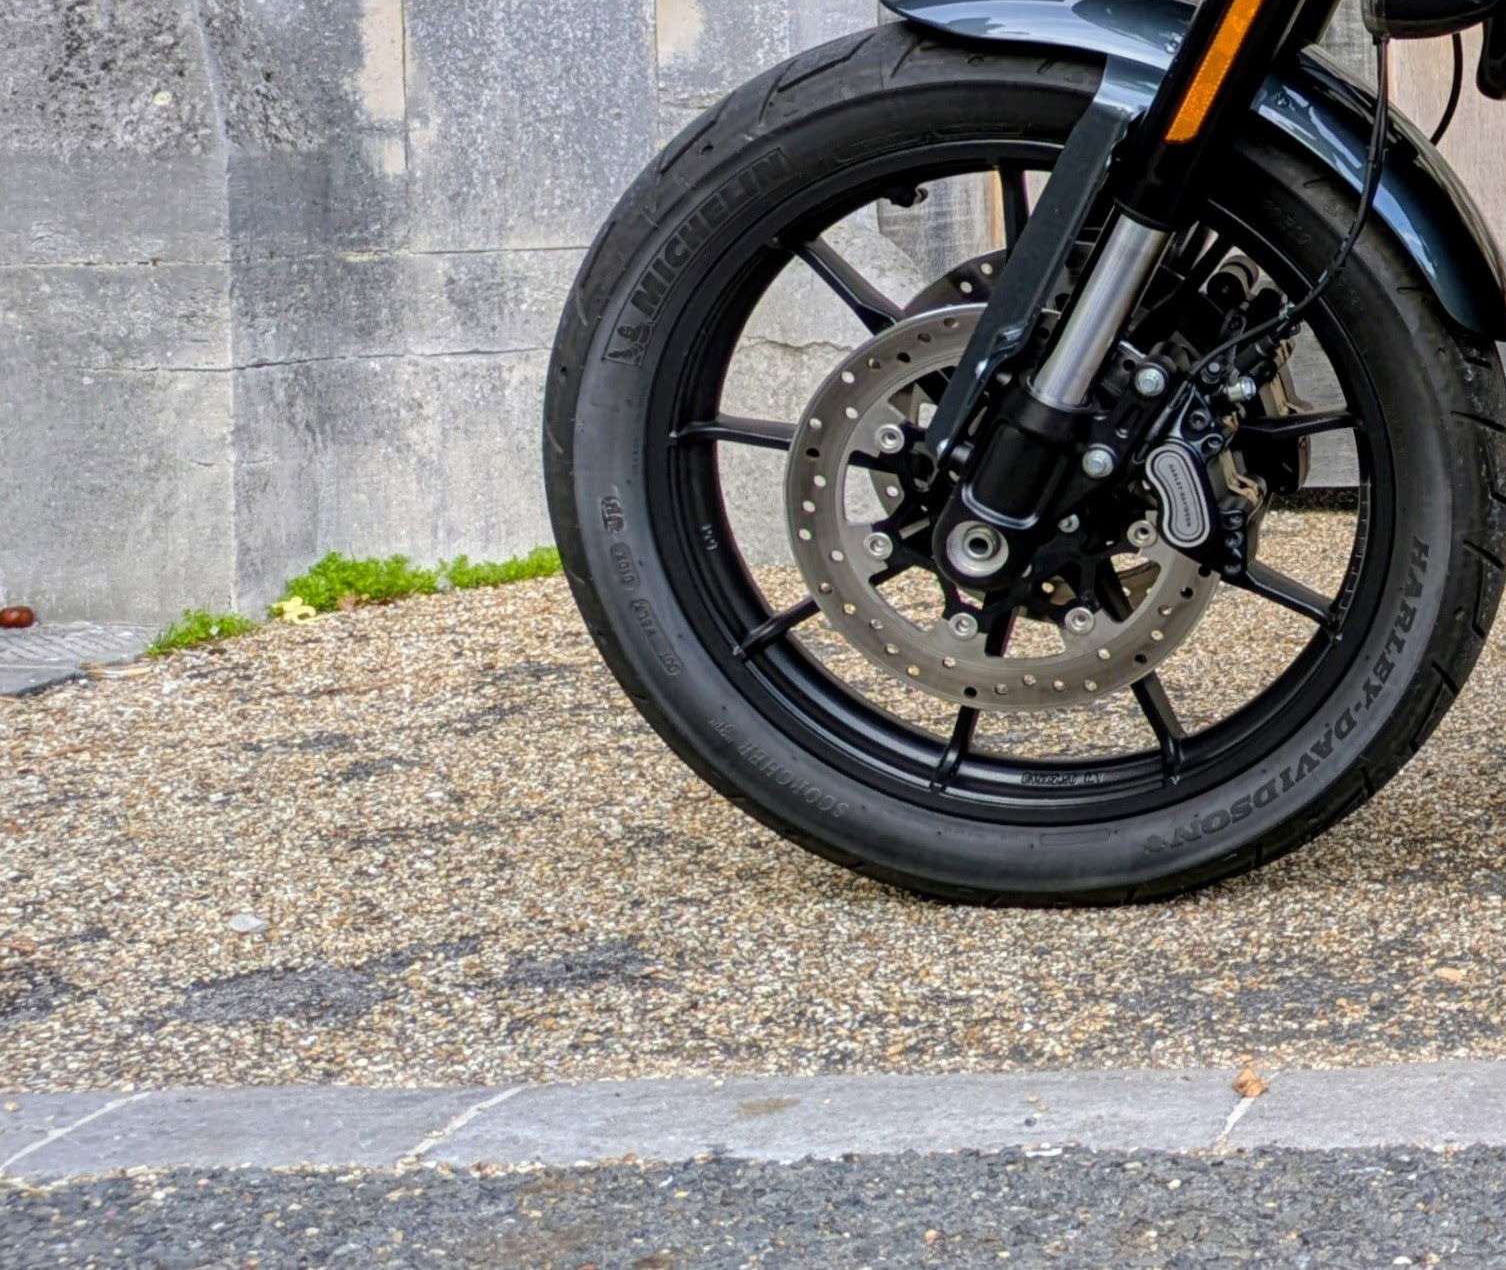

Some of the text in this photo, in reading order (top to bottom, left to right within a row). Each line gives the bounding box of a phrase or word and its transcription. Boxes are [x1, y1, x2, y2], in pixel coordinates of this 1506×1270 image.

[630, 151, 790, 312] MICHELIN
[1168, 463, 1192, 528] HARLEY-DAVIDSON
[1169, 534, 1430, 851] HARLEY-DAVIDSON
[736, 735, 849, 820] SCORCHER
